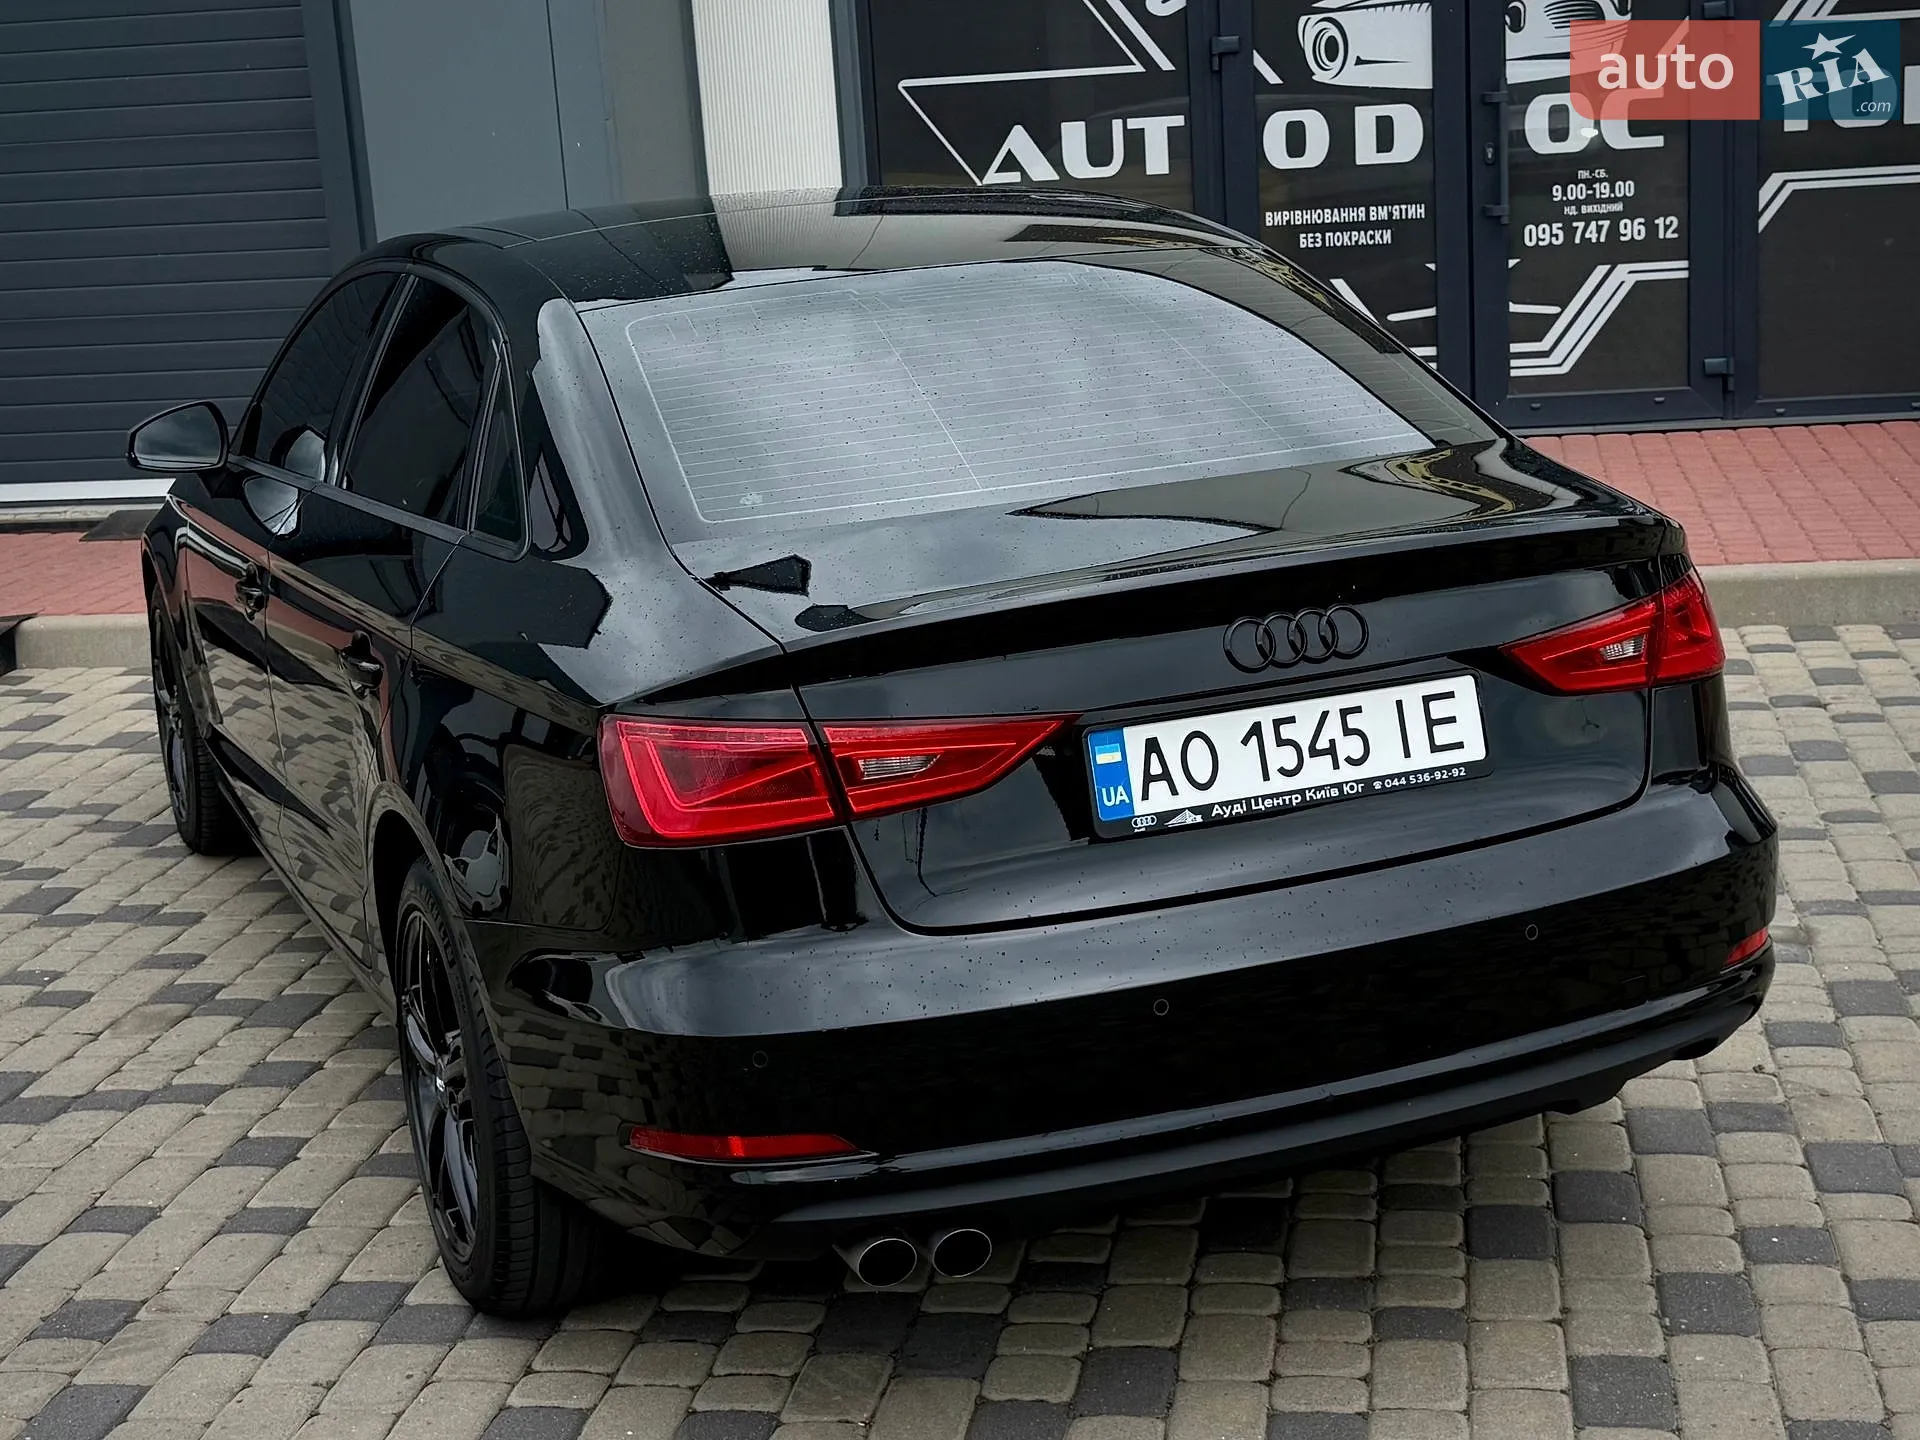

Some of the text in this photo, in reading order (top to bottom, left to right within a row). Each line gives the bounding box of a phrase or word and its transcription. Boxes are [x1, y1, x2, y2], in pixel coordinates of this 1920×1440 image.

[1552, 180, 1635, 202] 9.00-19.00
[1265, 203, 1426, 227] ВИРІВНЮВАННЯ ВМ'ЯТИН
[1299, 228, 1392, 249] БЕЗ ПОКРАСКИ
[1523, 215, 1679, 247] 095 747 96 12
[1141, 690, 1465, 801] AO 1545 IE
[1102, 785, 1130, 807] UA
[1211, 767, 1467, 818] Ауді Центр Київ Юг 044 536-92-92
